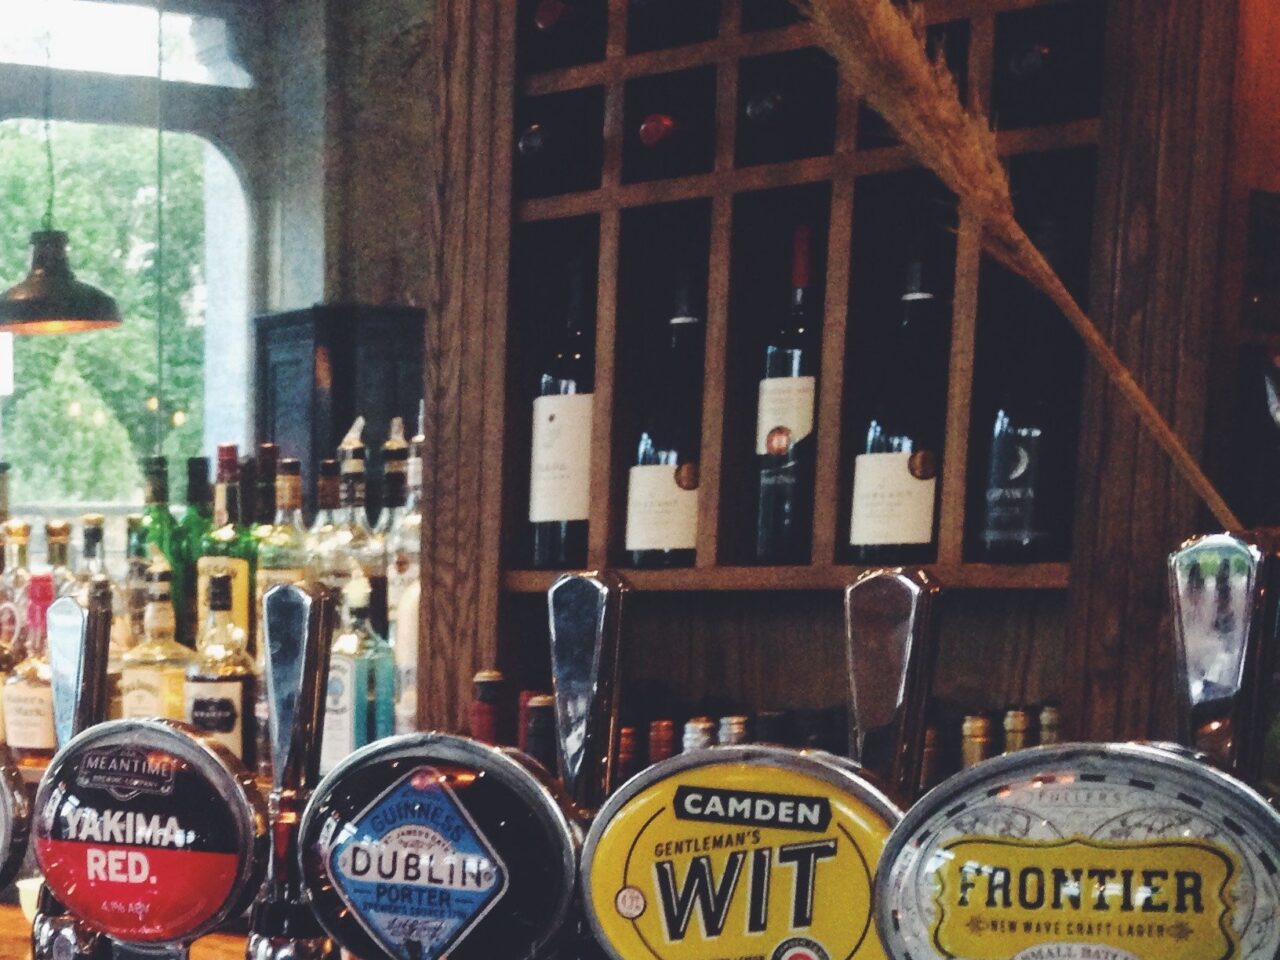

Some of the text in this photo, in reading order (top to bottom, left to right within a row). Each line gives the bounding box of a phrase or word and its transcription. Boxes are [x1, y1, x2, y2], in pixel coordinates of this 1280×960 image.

[86, 756, 169, 777] MEANTIME
[66, 807, 185, 848] YAKIMA
[371, 801, 465, 843] GUINNESS
[683, 793, 821, 826] CAMDEN
[654, 830, 762, 858] GENTLEMAN'S
[86, 847, 157, 885] RED.
[351, 846, 482, 889] DUBLIN
[376, 882, 451, 907] PORTER
[653, 837, 839, 943] WIT
[957, 865, 1205, 913] FRONTIER
[990, 920, 1166, 938] NEW WAVE CRAFT LAGER
